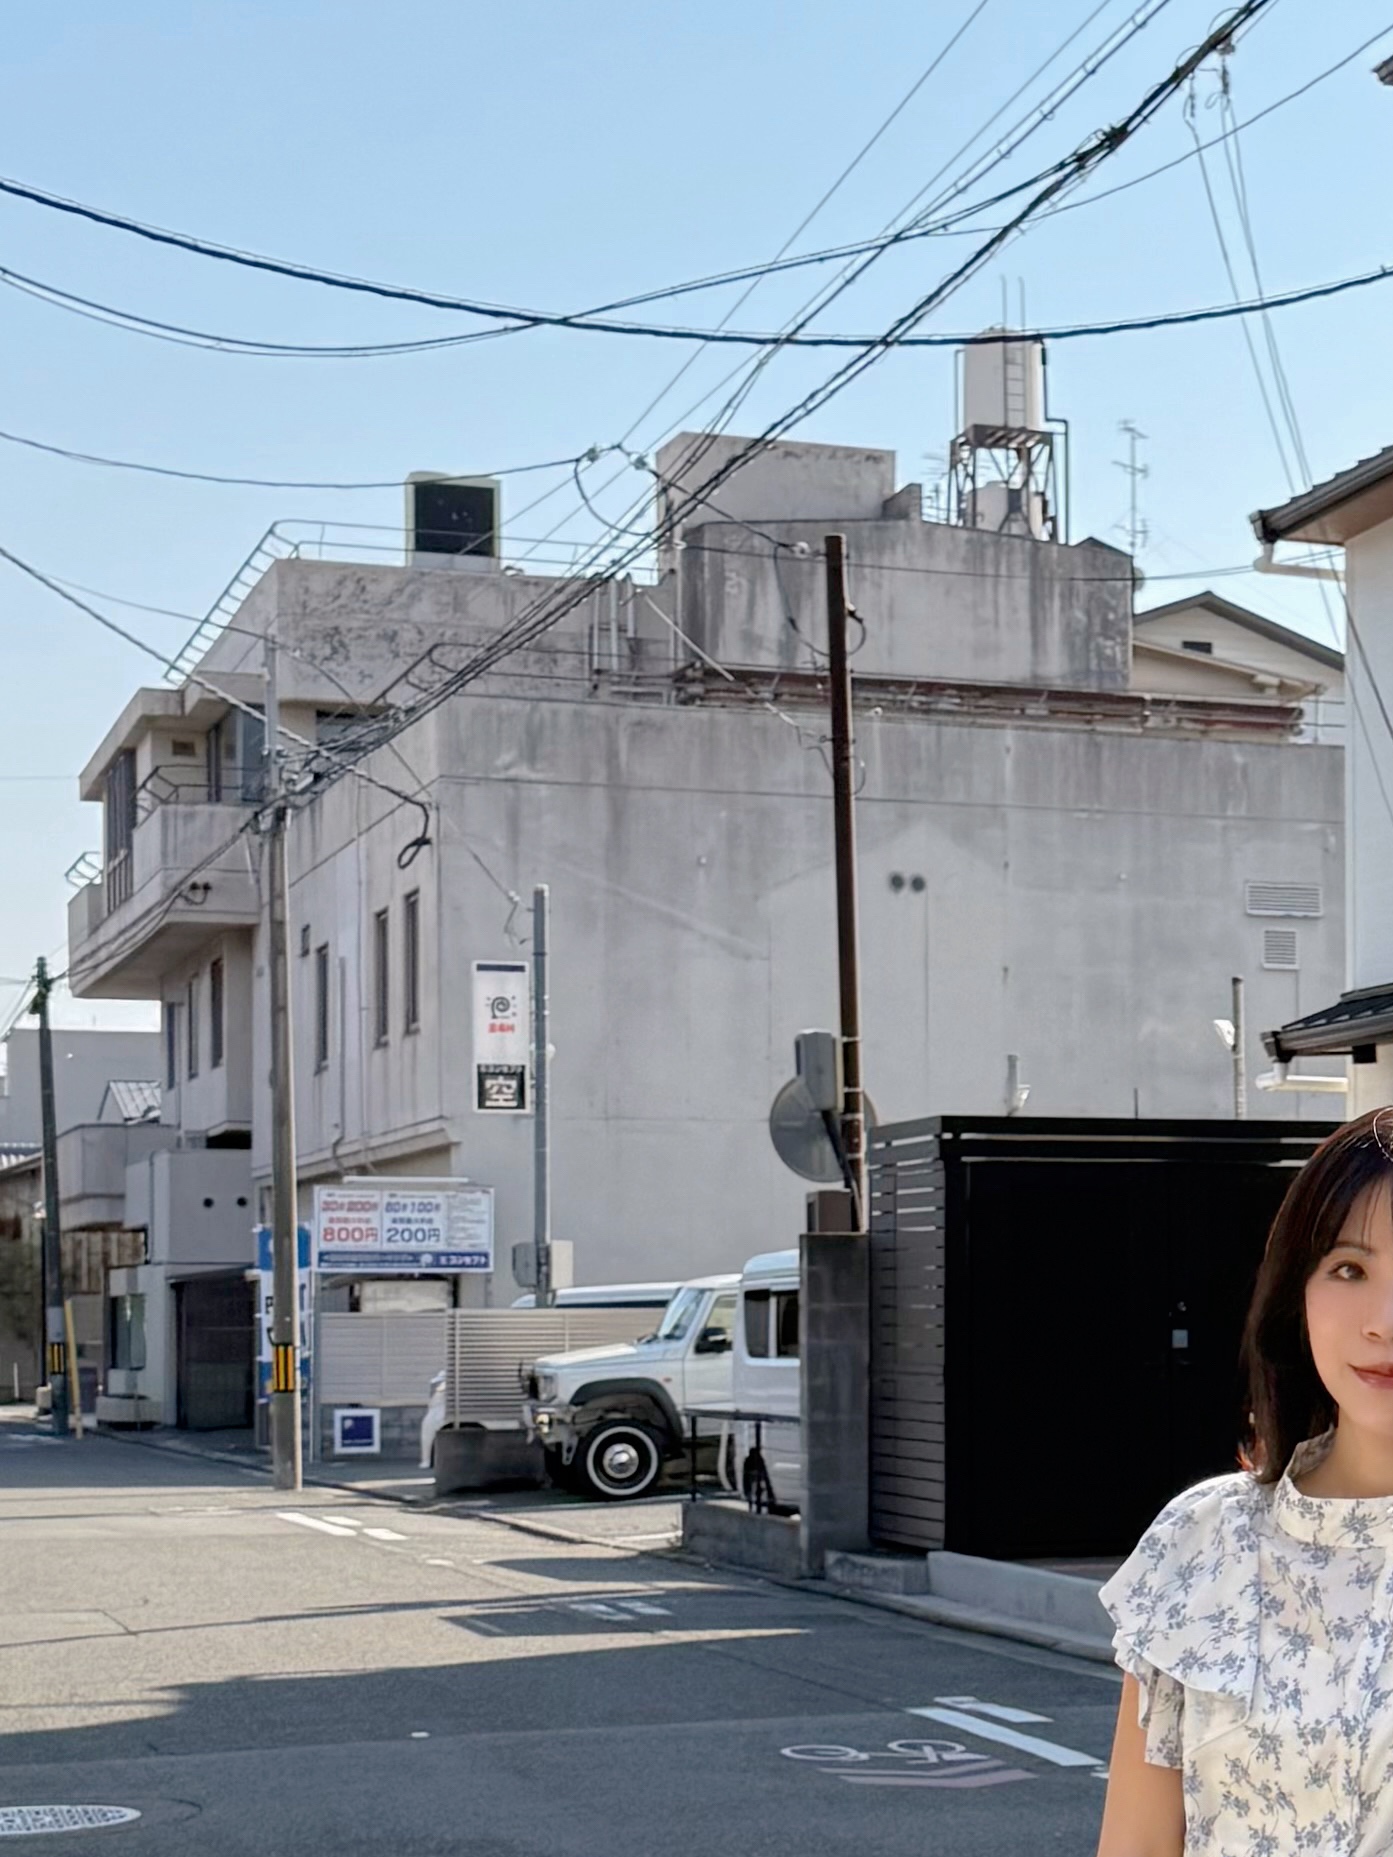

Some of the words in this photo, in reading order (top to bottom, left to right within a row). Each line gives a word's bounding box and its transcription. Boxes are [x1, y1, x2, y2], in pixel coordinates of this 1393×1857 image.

[485, 1075, 518, 1107] 空
[322, 1226, 378, 1242] 800円
[386, 1227, 440, 1243] 200円
